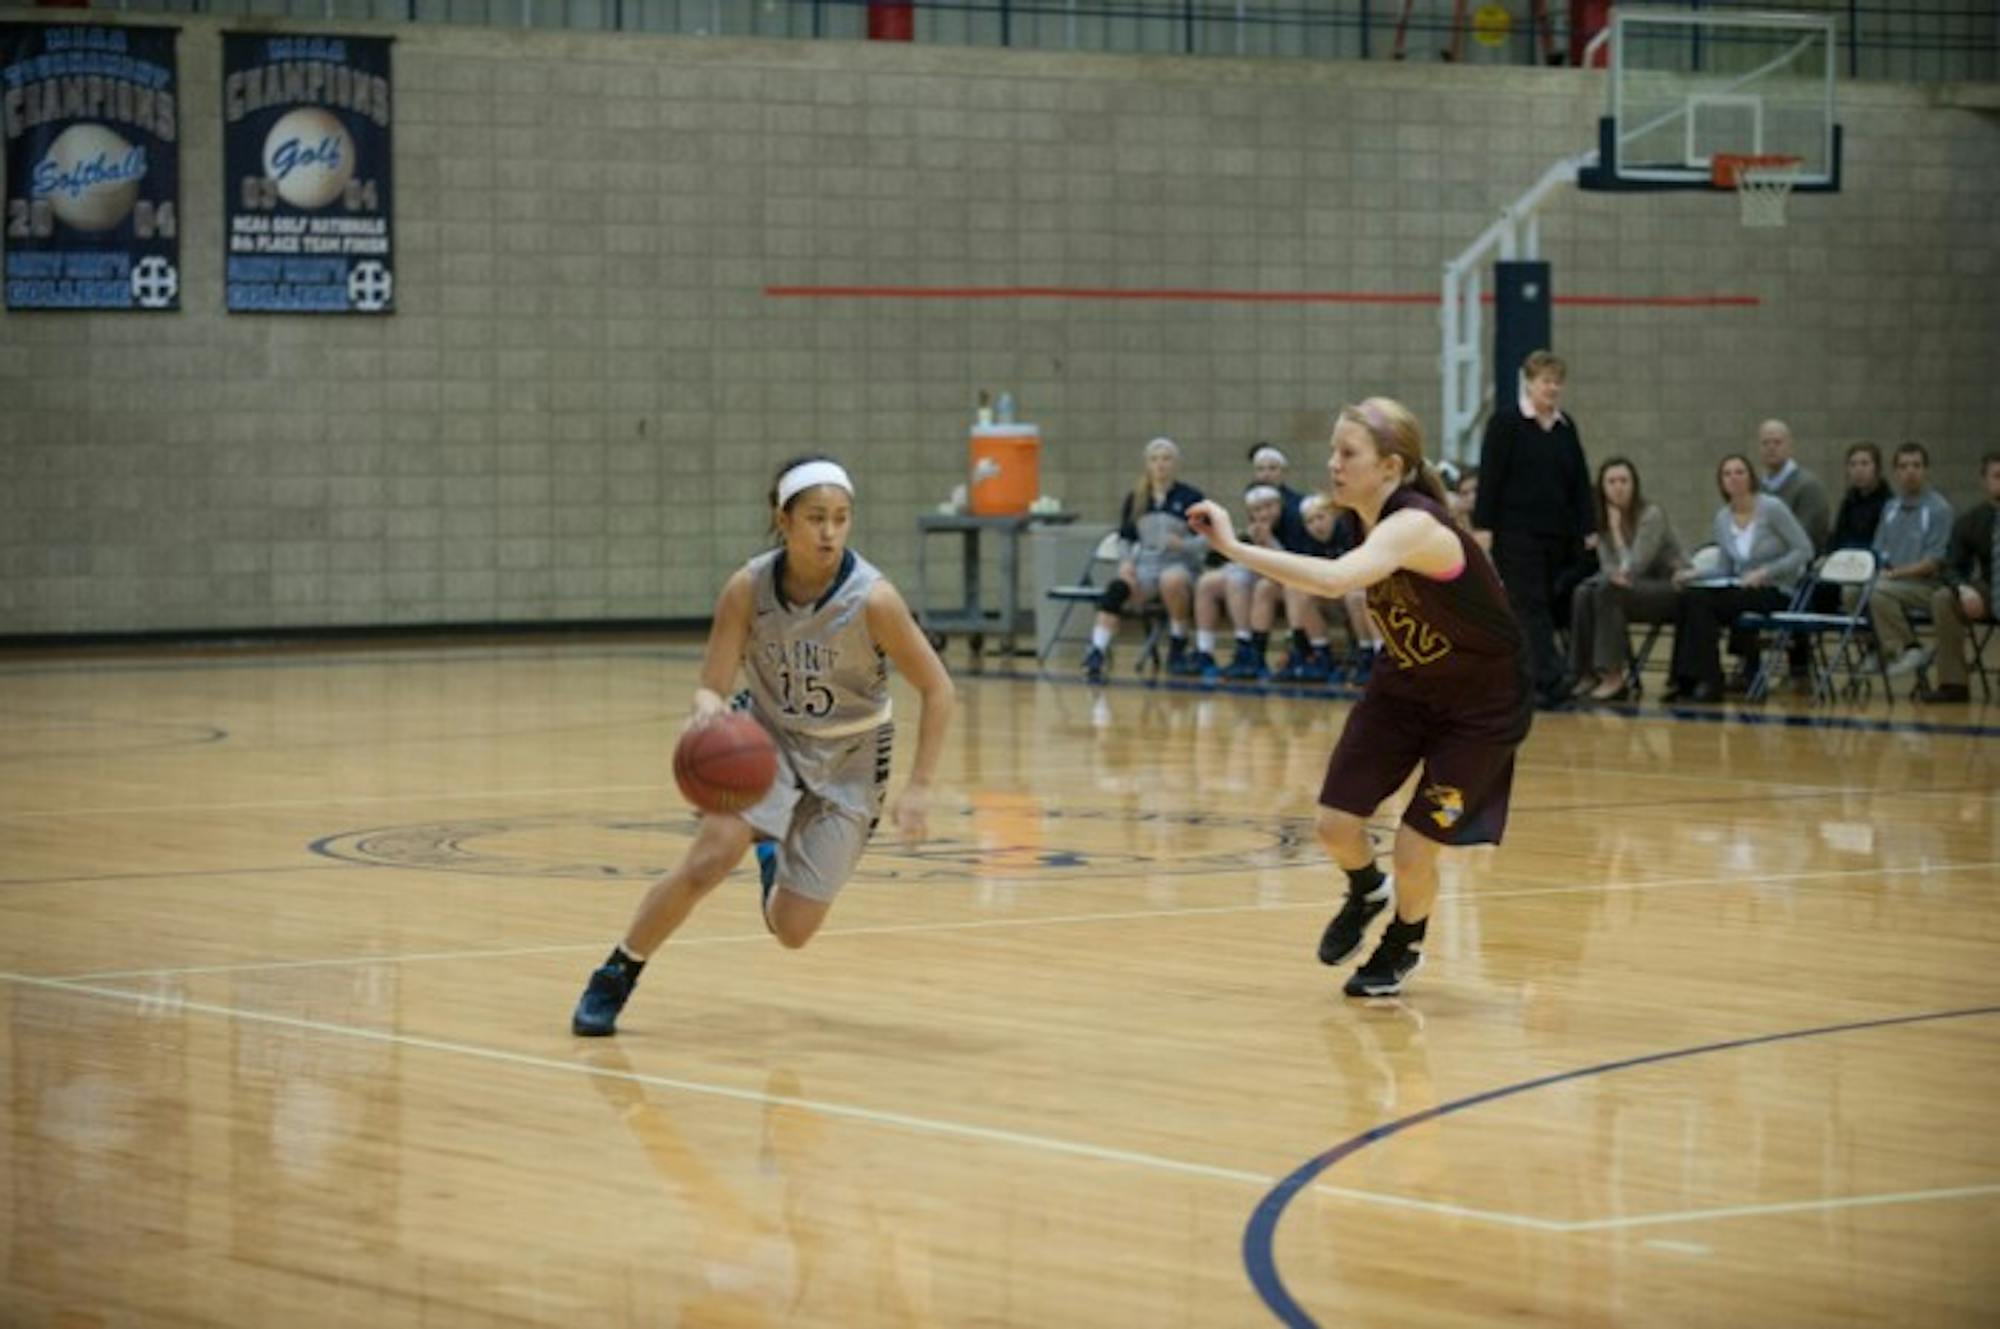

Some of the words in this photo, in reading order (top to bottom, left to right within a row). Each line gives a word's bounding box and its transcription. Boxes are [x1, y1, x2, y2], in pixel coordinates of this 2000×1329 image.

[5, 76, 176, 142] CHAMPIONS
[226, 61, 389, 127] CHAMPIONS
[33, 145, 147, 199] Softball
[271, 136, 342, 181] Golf
[256, 235, 300, 252] PLACE
[302, 236, 341, 253] TEAM
[780, 671, 835, 718] 15
